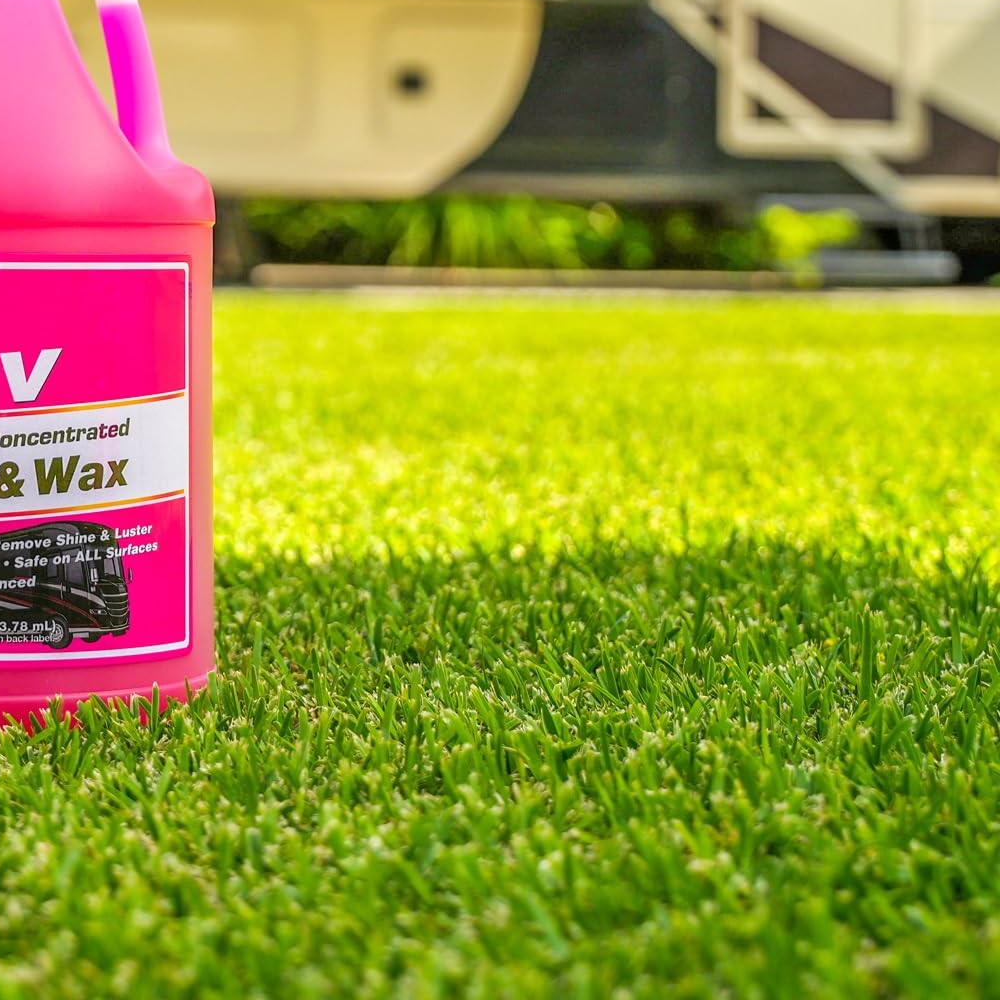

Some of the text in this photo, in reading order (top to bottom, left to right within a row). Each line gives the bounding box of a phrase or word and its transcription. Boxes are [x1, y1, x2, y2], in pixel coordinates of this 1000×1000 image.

[34, 455, 130, 495] Wax
[56, 532, 96, 546] Shine
[100, 529, 111, 541] &
[114, 524, 153, 539] Luster
[14, 542, 158, 569] Safe on ALL Surfaces
[32, 619, 57, 633] mL)
[6, 633, 28, 643] back
